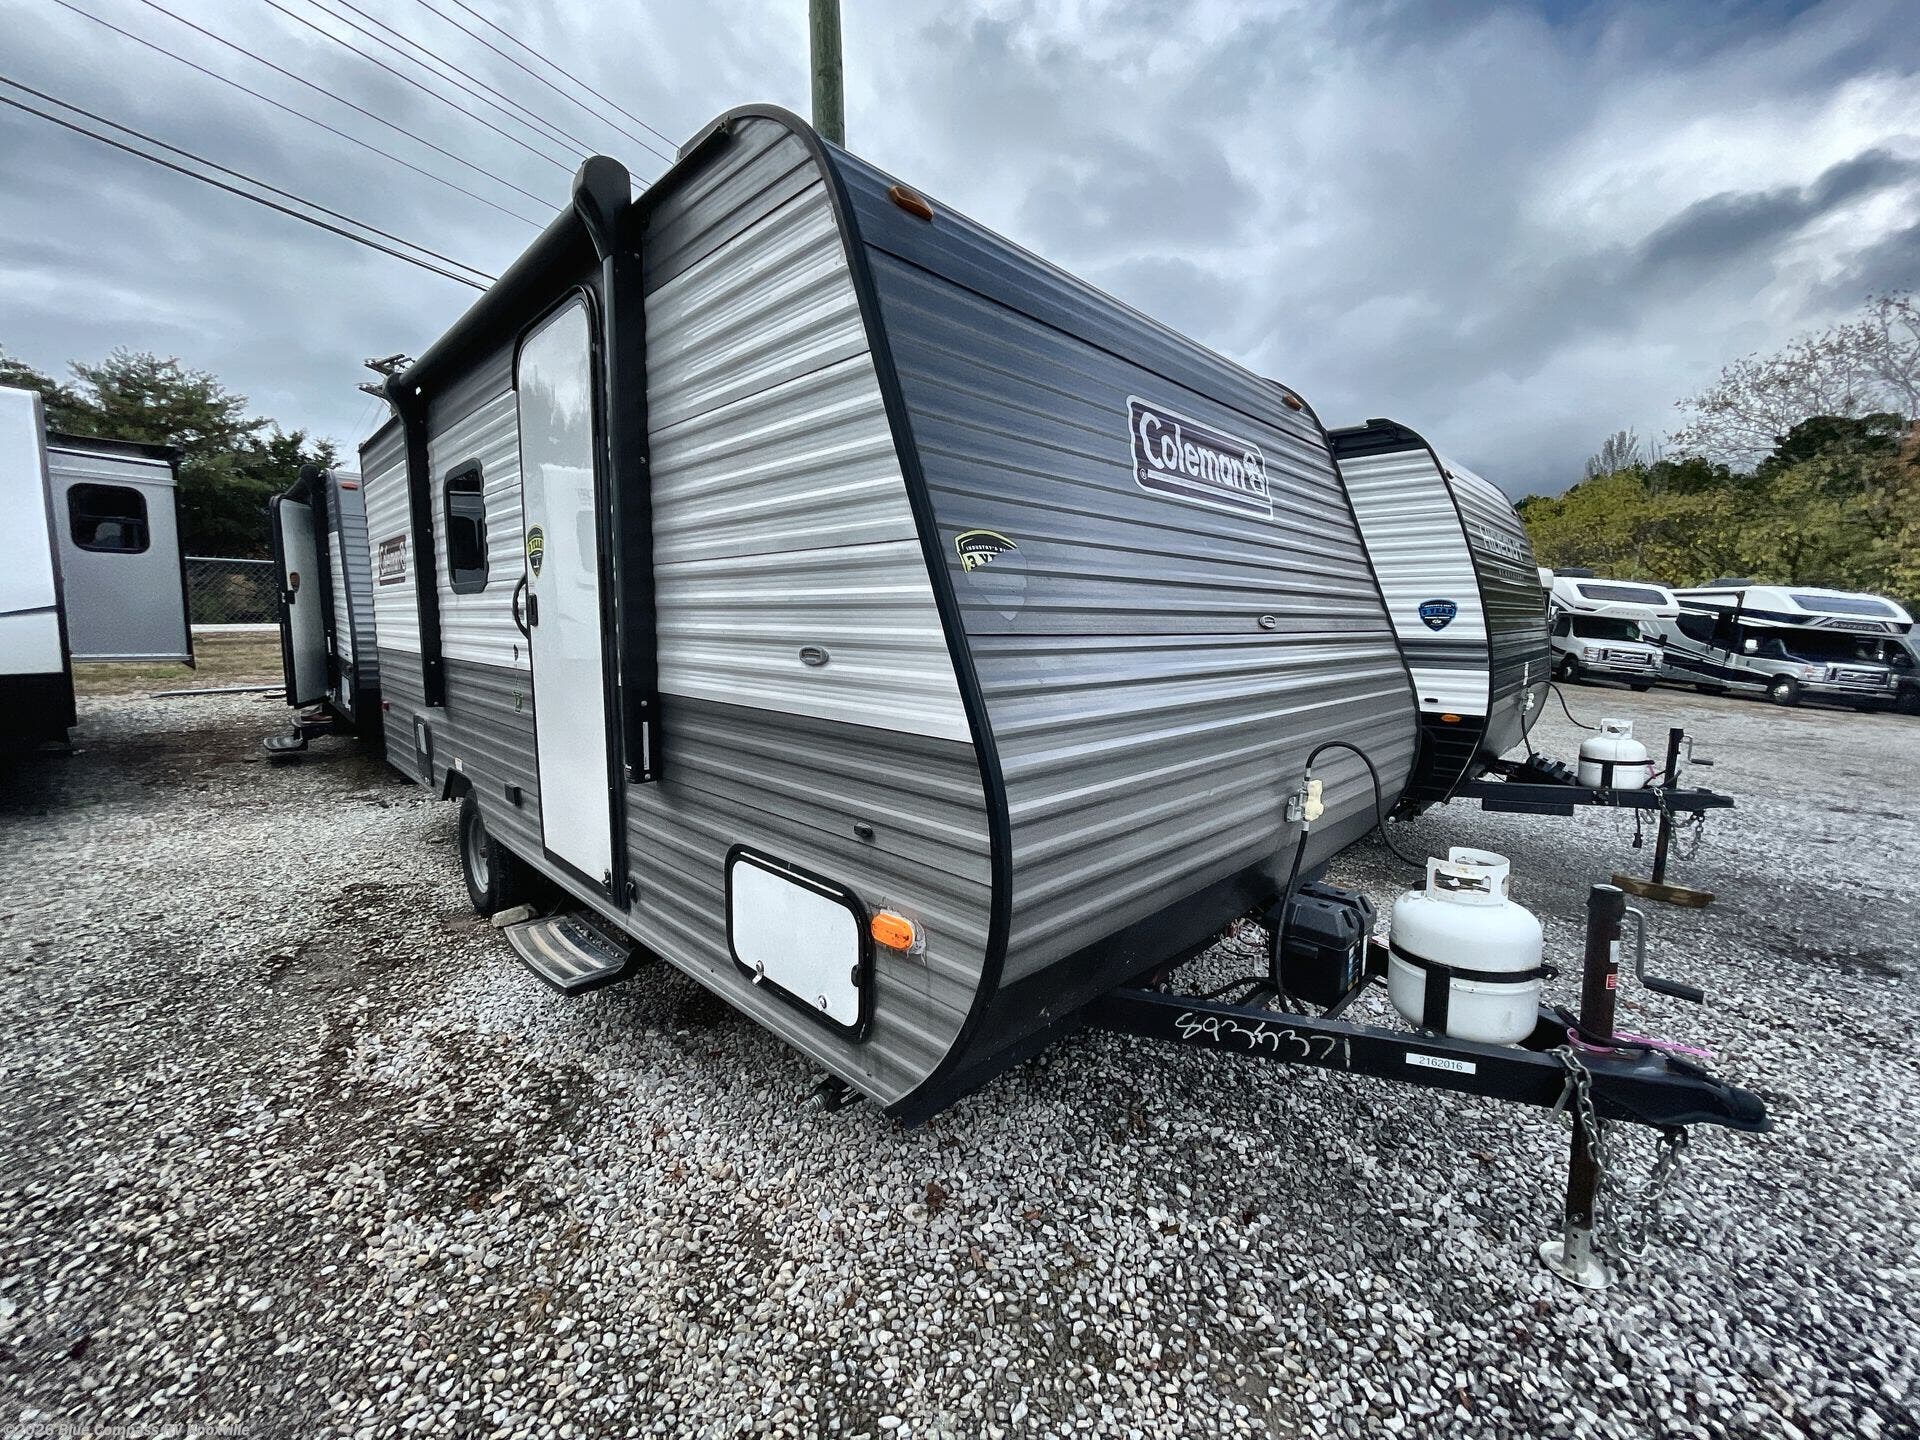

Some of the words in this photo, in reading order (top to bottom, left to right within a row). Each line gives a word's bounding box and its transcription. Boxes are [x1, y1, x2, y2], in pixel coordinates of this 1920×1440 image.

[1139, 411, 1248, 491] Coleman
[967, 555, 977, 569] 3
[1418, 1056, 1463, 1071] 2162016
